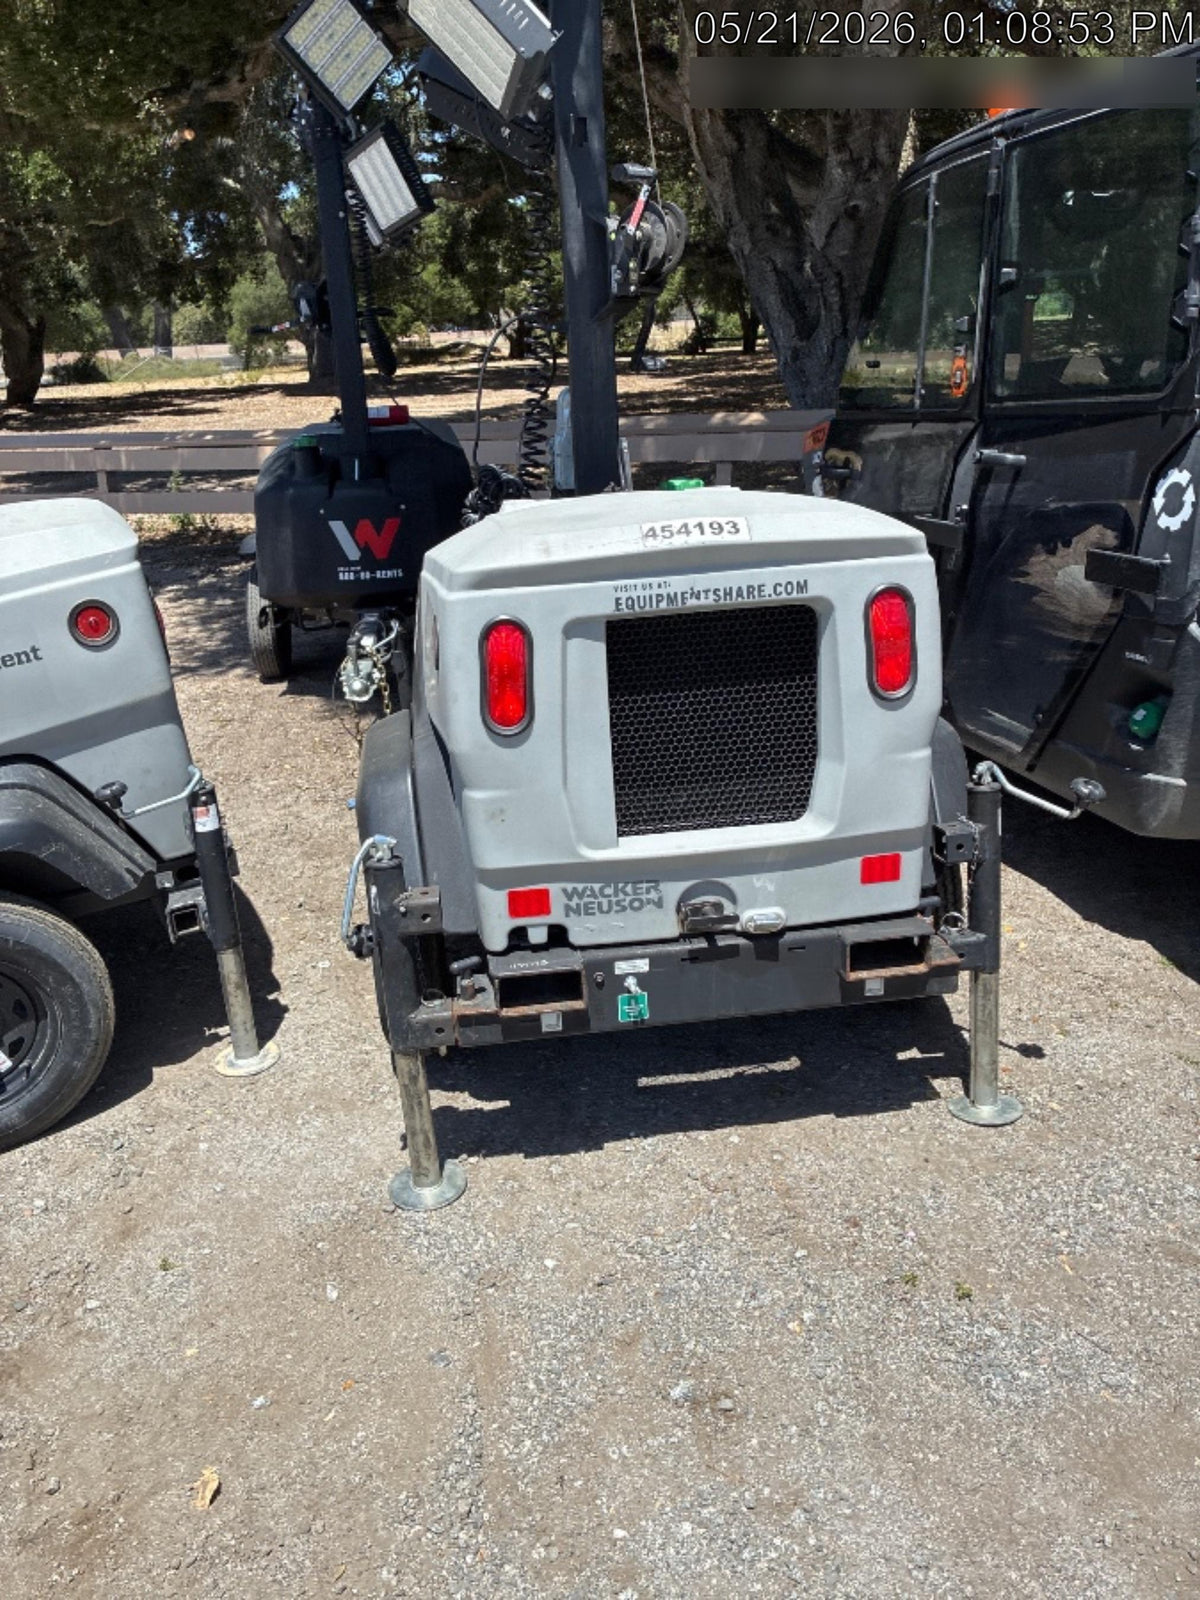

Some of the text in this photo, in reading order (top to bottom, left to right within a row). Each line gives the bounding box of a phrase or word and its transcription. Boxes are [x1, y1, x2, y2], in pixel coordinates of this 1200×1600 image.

[643, 519, 741, 541] 454193
[613, 583, 638, 593] VISIT
[641, 582, 654, 591] US
[0, 645, 44, 669] ent
[561, 879, 663, 902] WACKER
[564, 895, 664, 918] NEUSON
